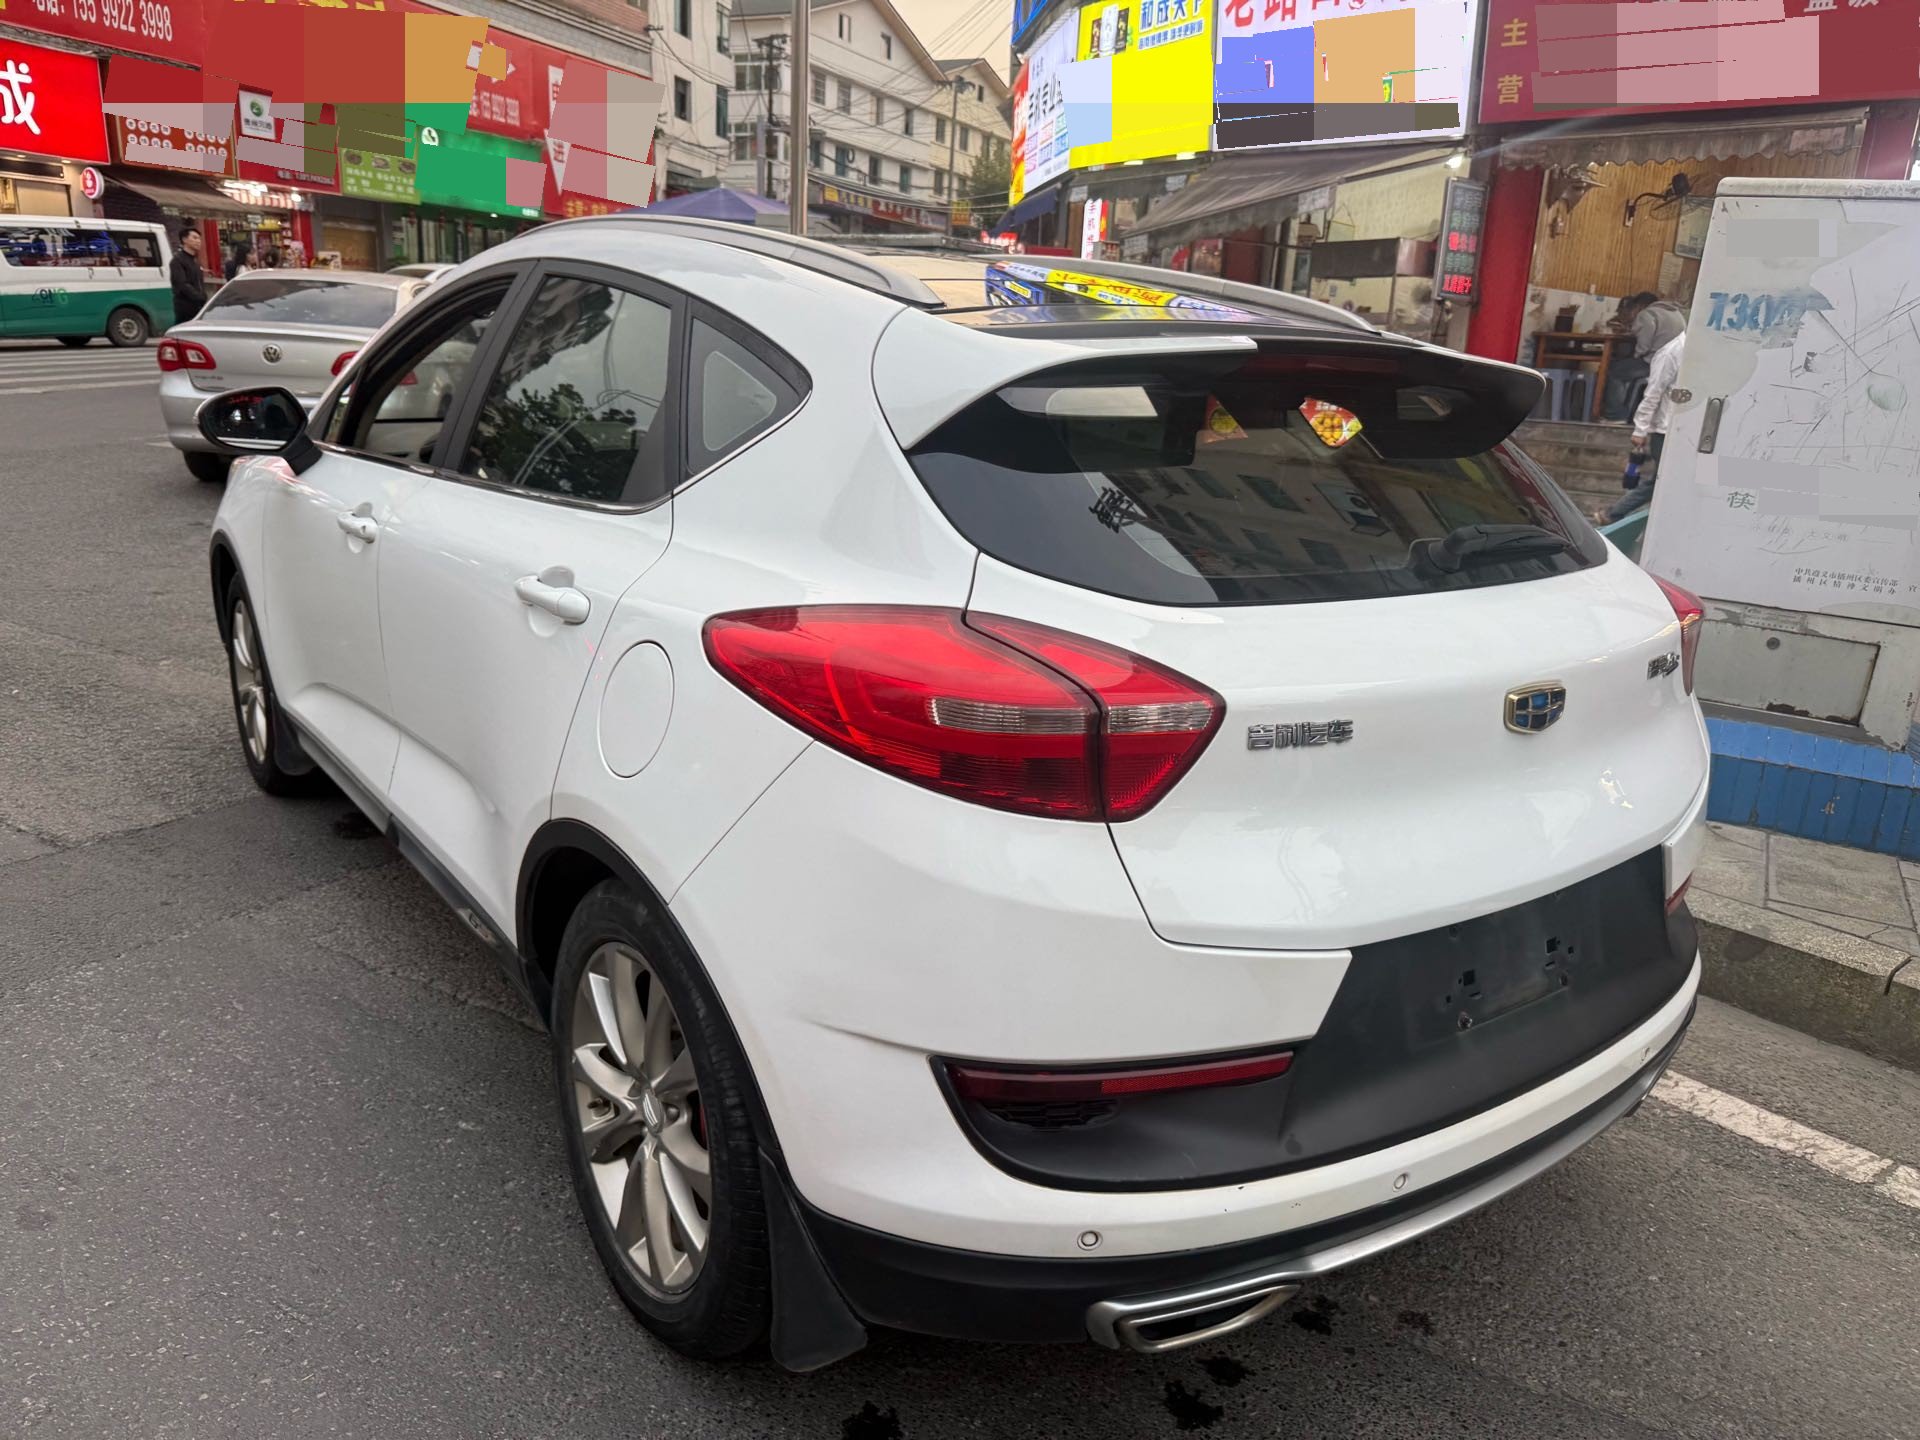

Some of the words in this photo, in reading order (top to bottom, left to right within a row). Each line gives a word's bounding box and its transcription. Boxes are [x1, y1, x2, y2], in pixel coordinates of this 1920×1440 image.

[139, 2, 173, 42] 3998
[1247, 719, 1354, 750] 吉利汽车
